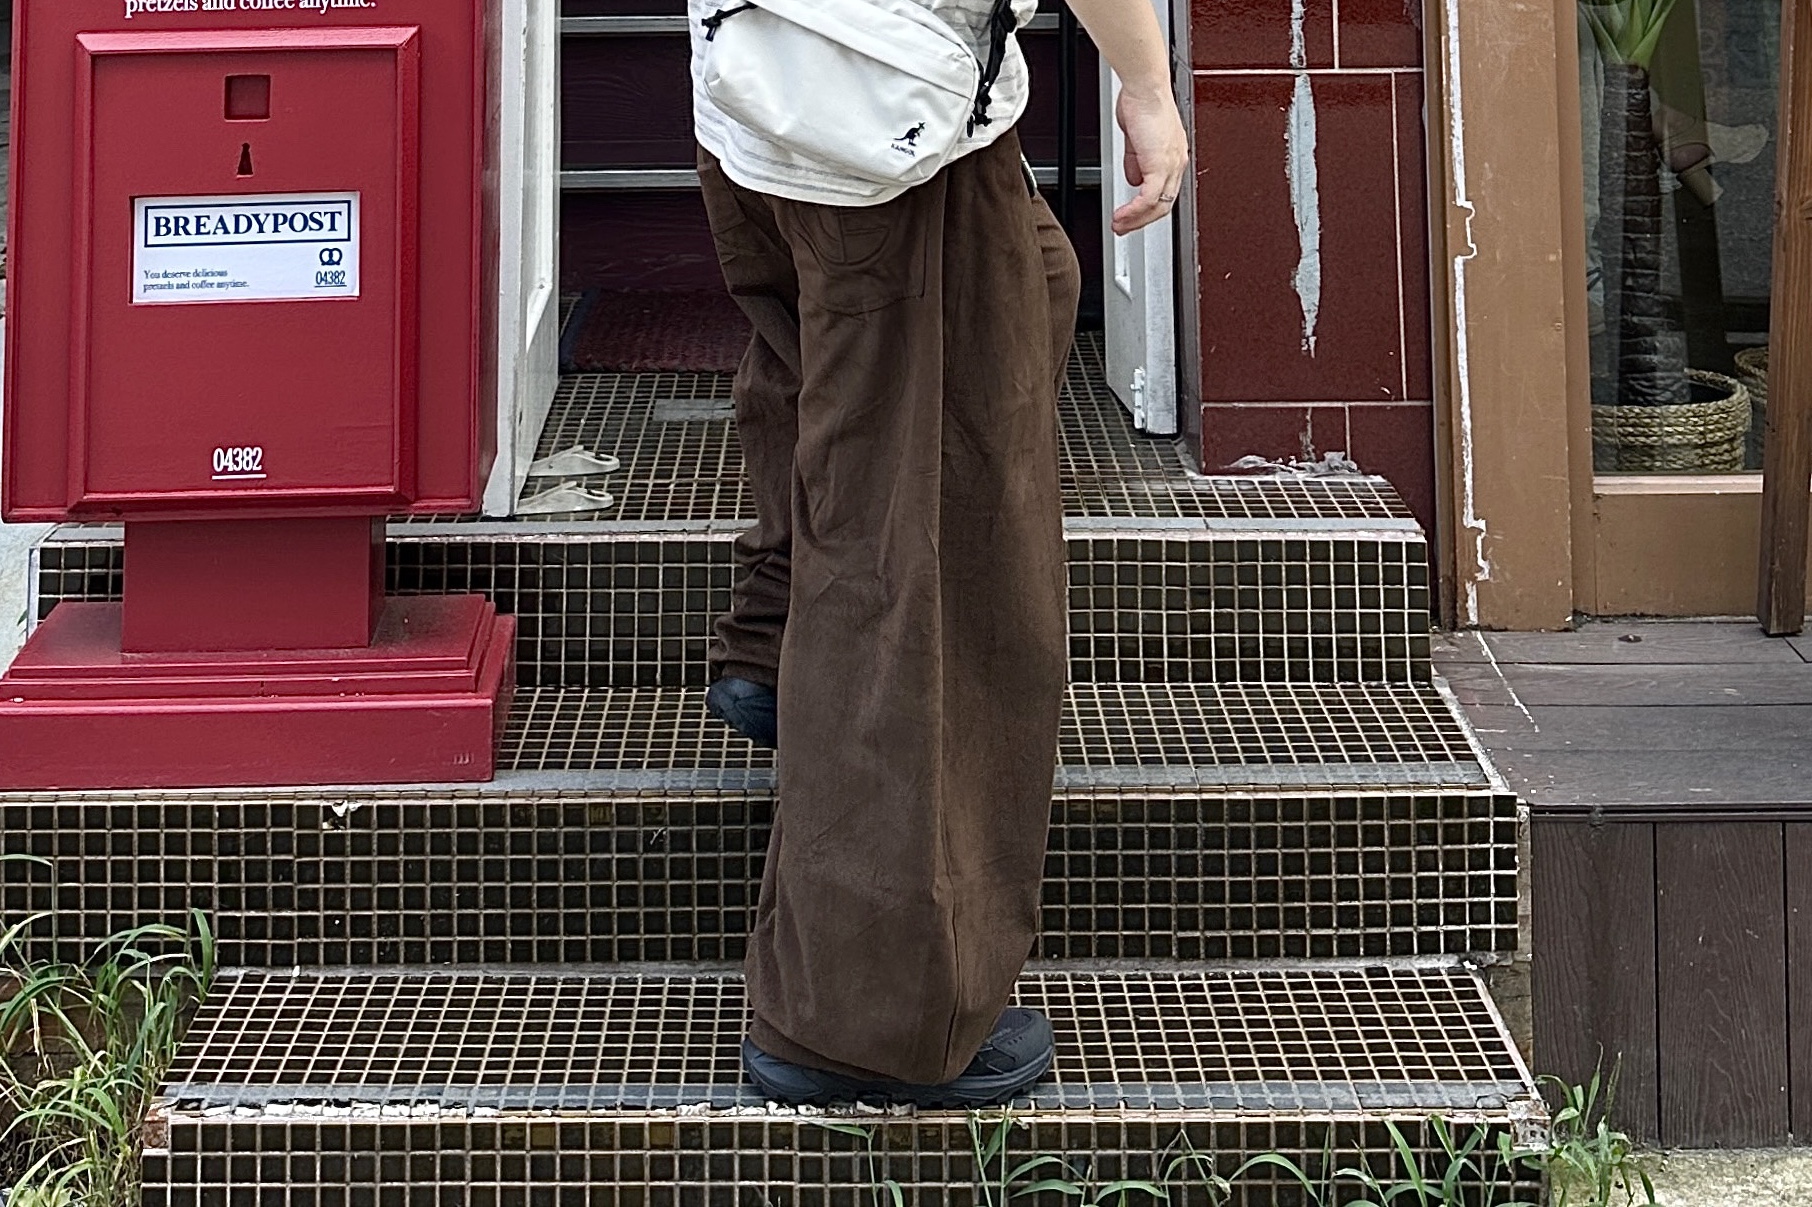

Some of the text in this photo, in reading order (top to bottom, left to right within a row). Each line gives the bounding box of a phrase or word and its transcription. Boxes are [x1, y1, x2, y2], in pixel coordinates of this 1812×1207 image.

[153, 210, 343, 237] BREADYPOST
[143, 268, 228, 279] You deserve delicious
[315, 270, 346, 285] 04382
[143, 281, 175, 293] pretzels
[176, 280, 190, 290] and
[191, 279, 215, 290] coffee
[213, 446, 263, 472] 04382
